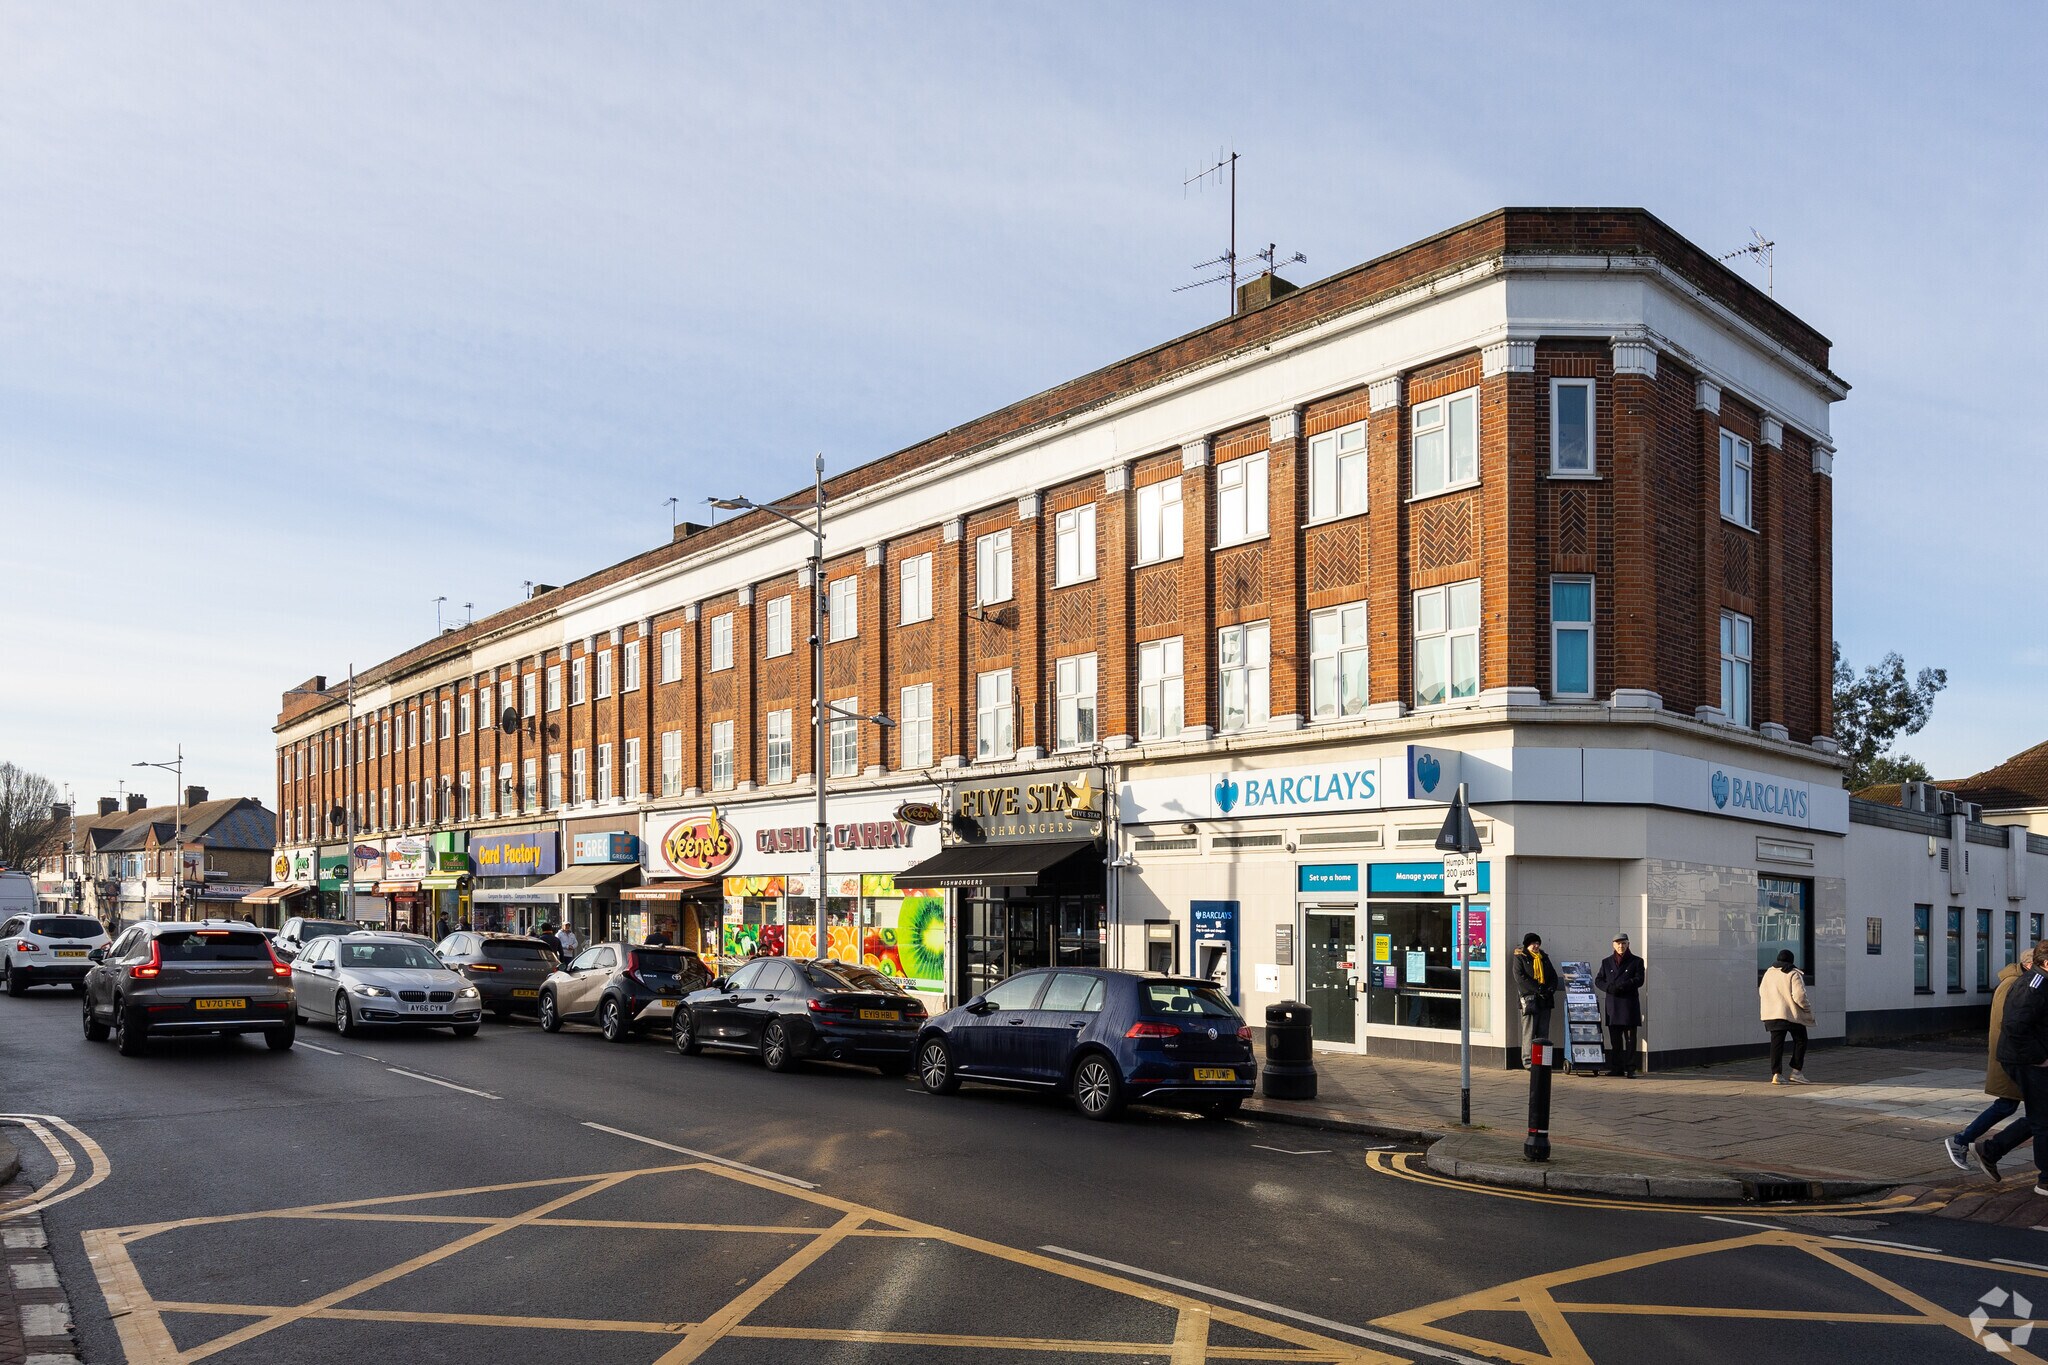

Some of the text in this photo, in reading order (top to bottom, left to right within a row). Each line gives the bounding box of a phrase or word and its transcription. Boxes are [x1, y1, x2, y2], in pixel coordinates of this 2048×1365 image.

[1245, 770, 1376, 807] BARCLAYS
[960, 782, 1072, 817] FIVE STA
[1732, 777, 1807, 818] BARCLAYS
[1073, 810, 1101, 819] FIVE STAR
[977, 822, 1073, 837] FISHMONGERS
[756, 827, 806, 852] CASH
[834, 821, 909, 849] CARRY
[585, 839, 607, 857] GREG
[665, 822, 730, 869] Veena's
[478, 843, 541, 868] Card Factory
[612, 852, 633, 860] GREGGS
[1446, 859, 1464, 867] Humps
[1396, 872, 1422, 881] Manage
[1446, 869, 1458, 877] 200
[1459, 868, 1475, 878] yards
[1202, 911, 1233, 919] BARCLAYS
[200, 1000, 223, 1008] LV70
[410, 1004, 429, 1012] AY66
[864, 1010, 894, 1019] EY19 HBL
[1199, 1069, 1215, 1079] EJ17
